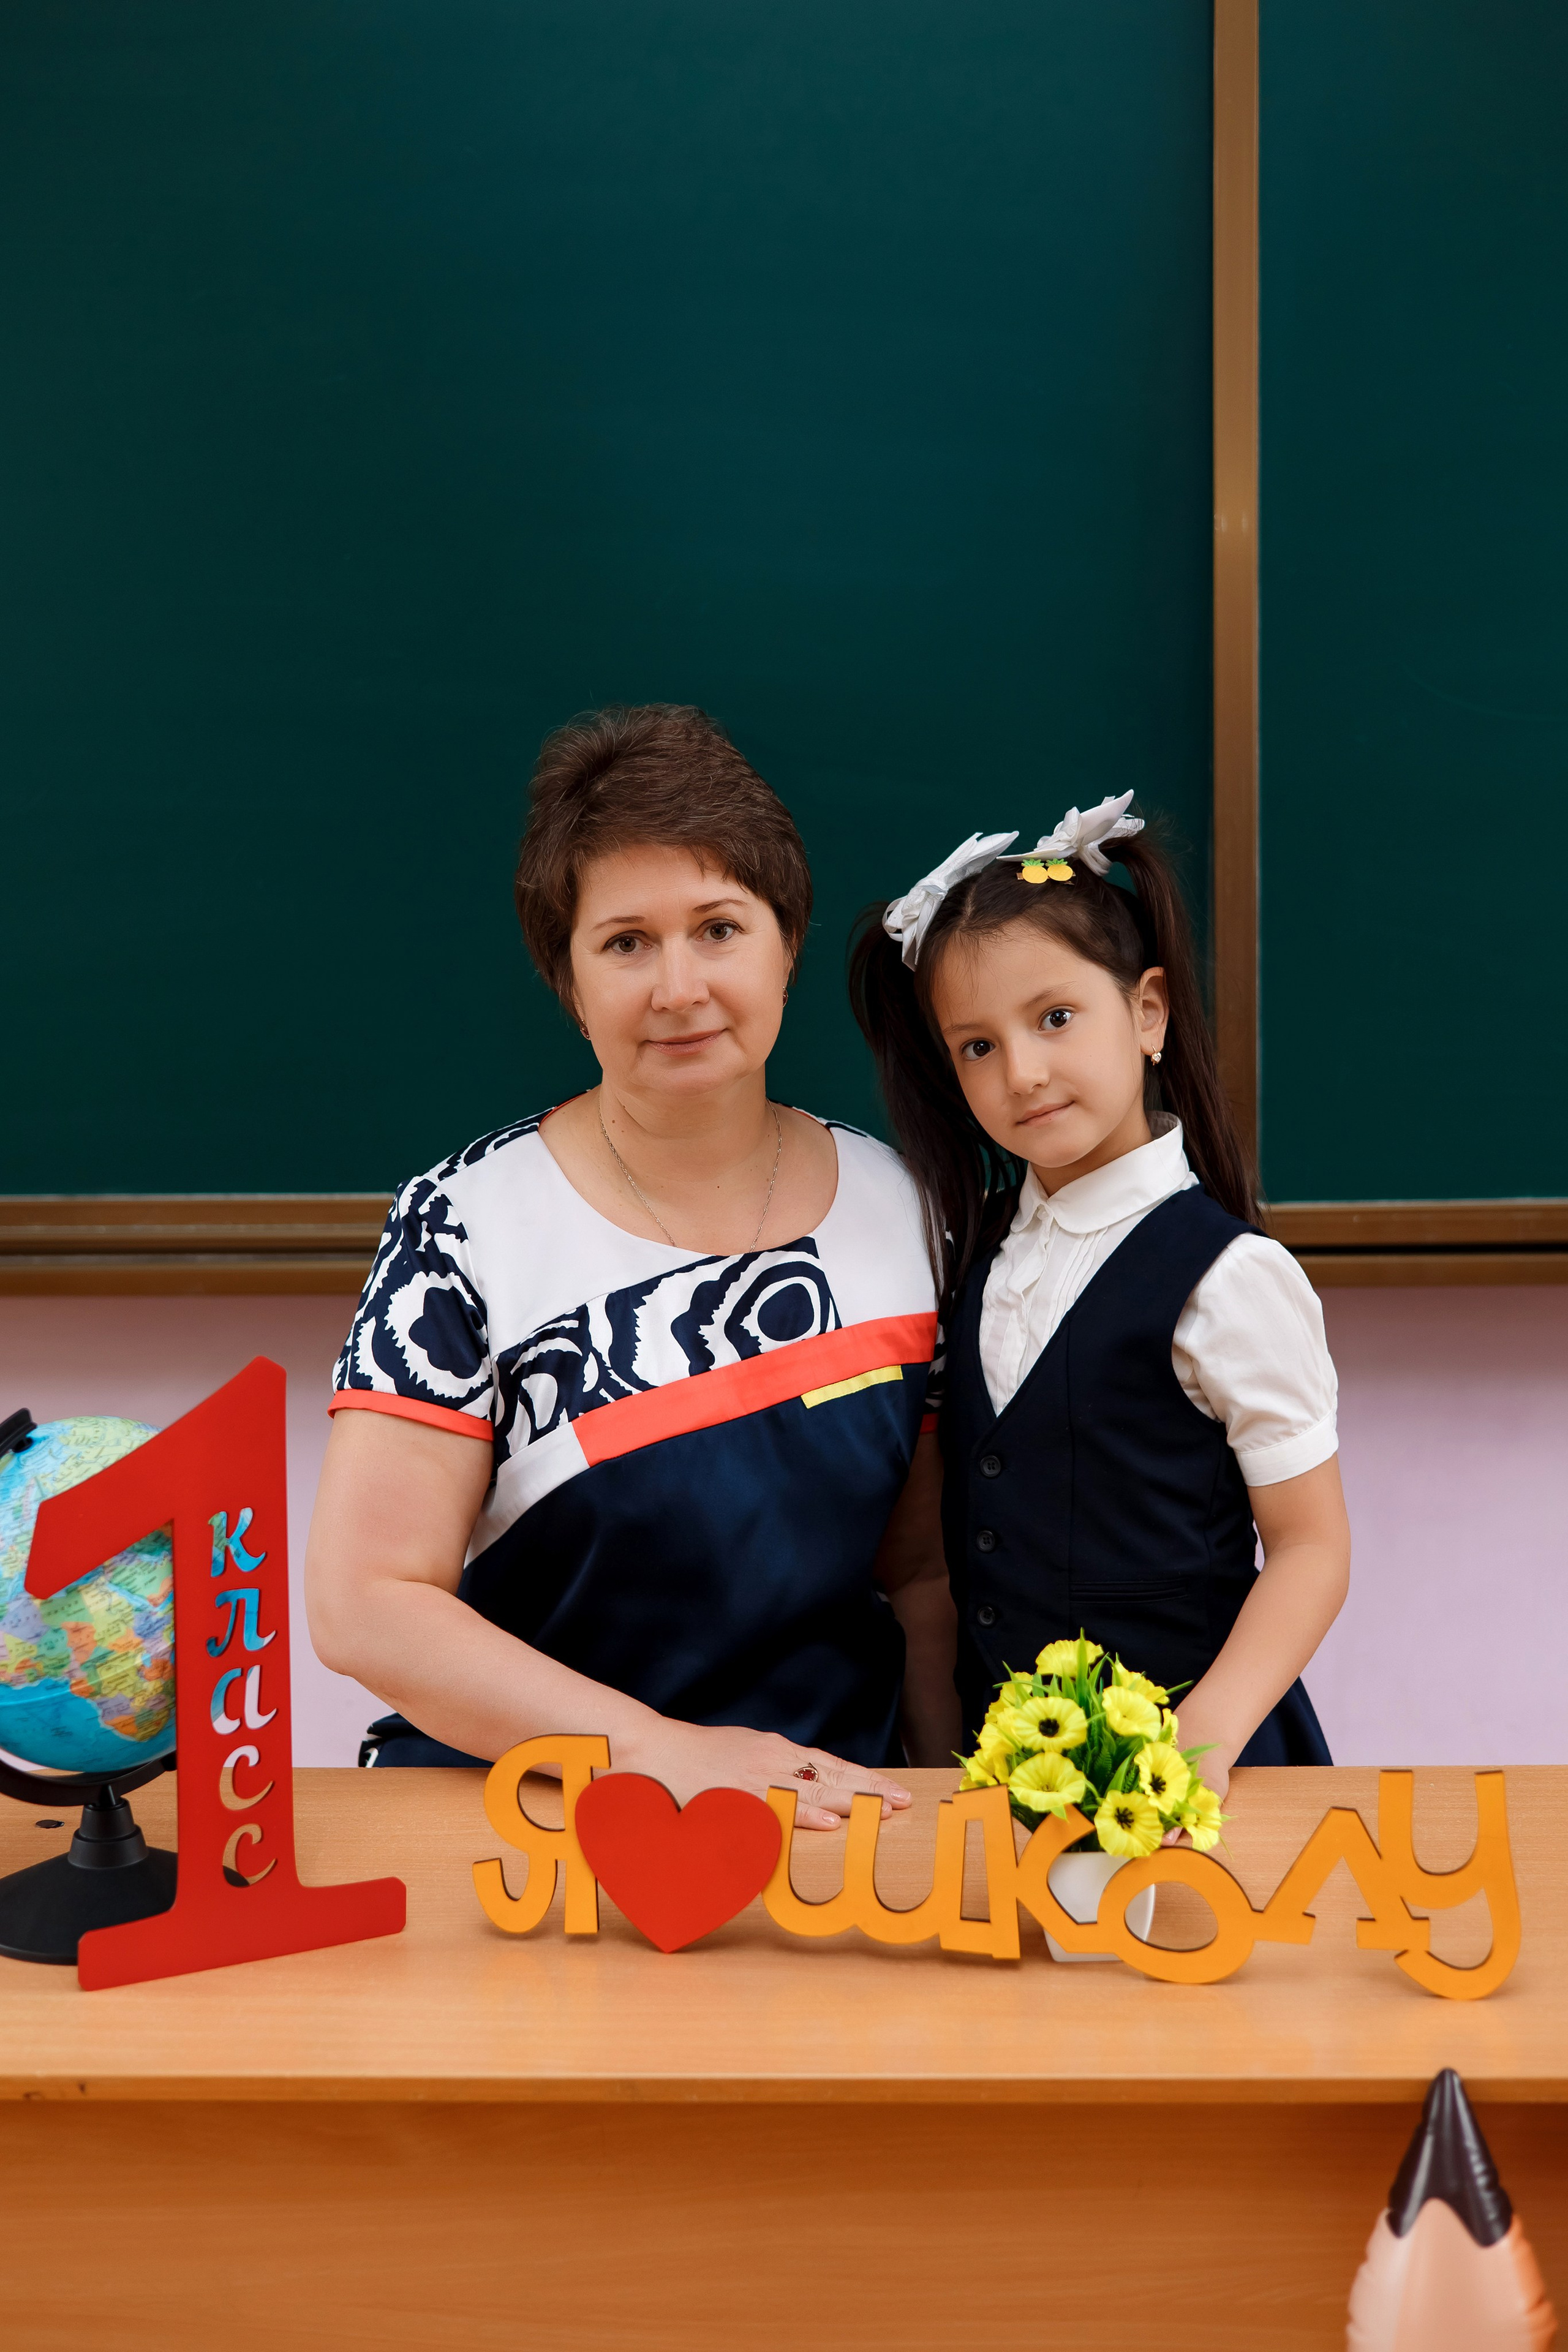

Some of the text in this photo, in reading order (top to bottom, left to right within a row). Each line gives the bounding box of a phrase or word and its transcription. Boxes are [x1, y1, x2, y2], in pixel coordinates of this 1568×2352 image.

[24, 1355, 407, 1991] 1
[206, 1507, 277, 1888] класс
[473, 1734, 1521, 1999] Я школу
